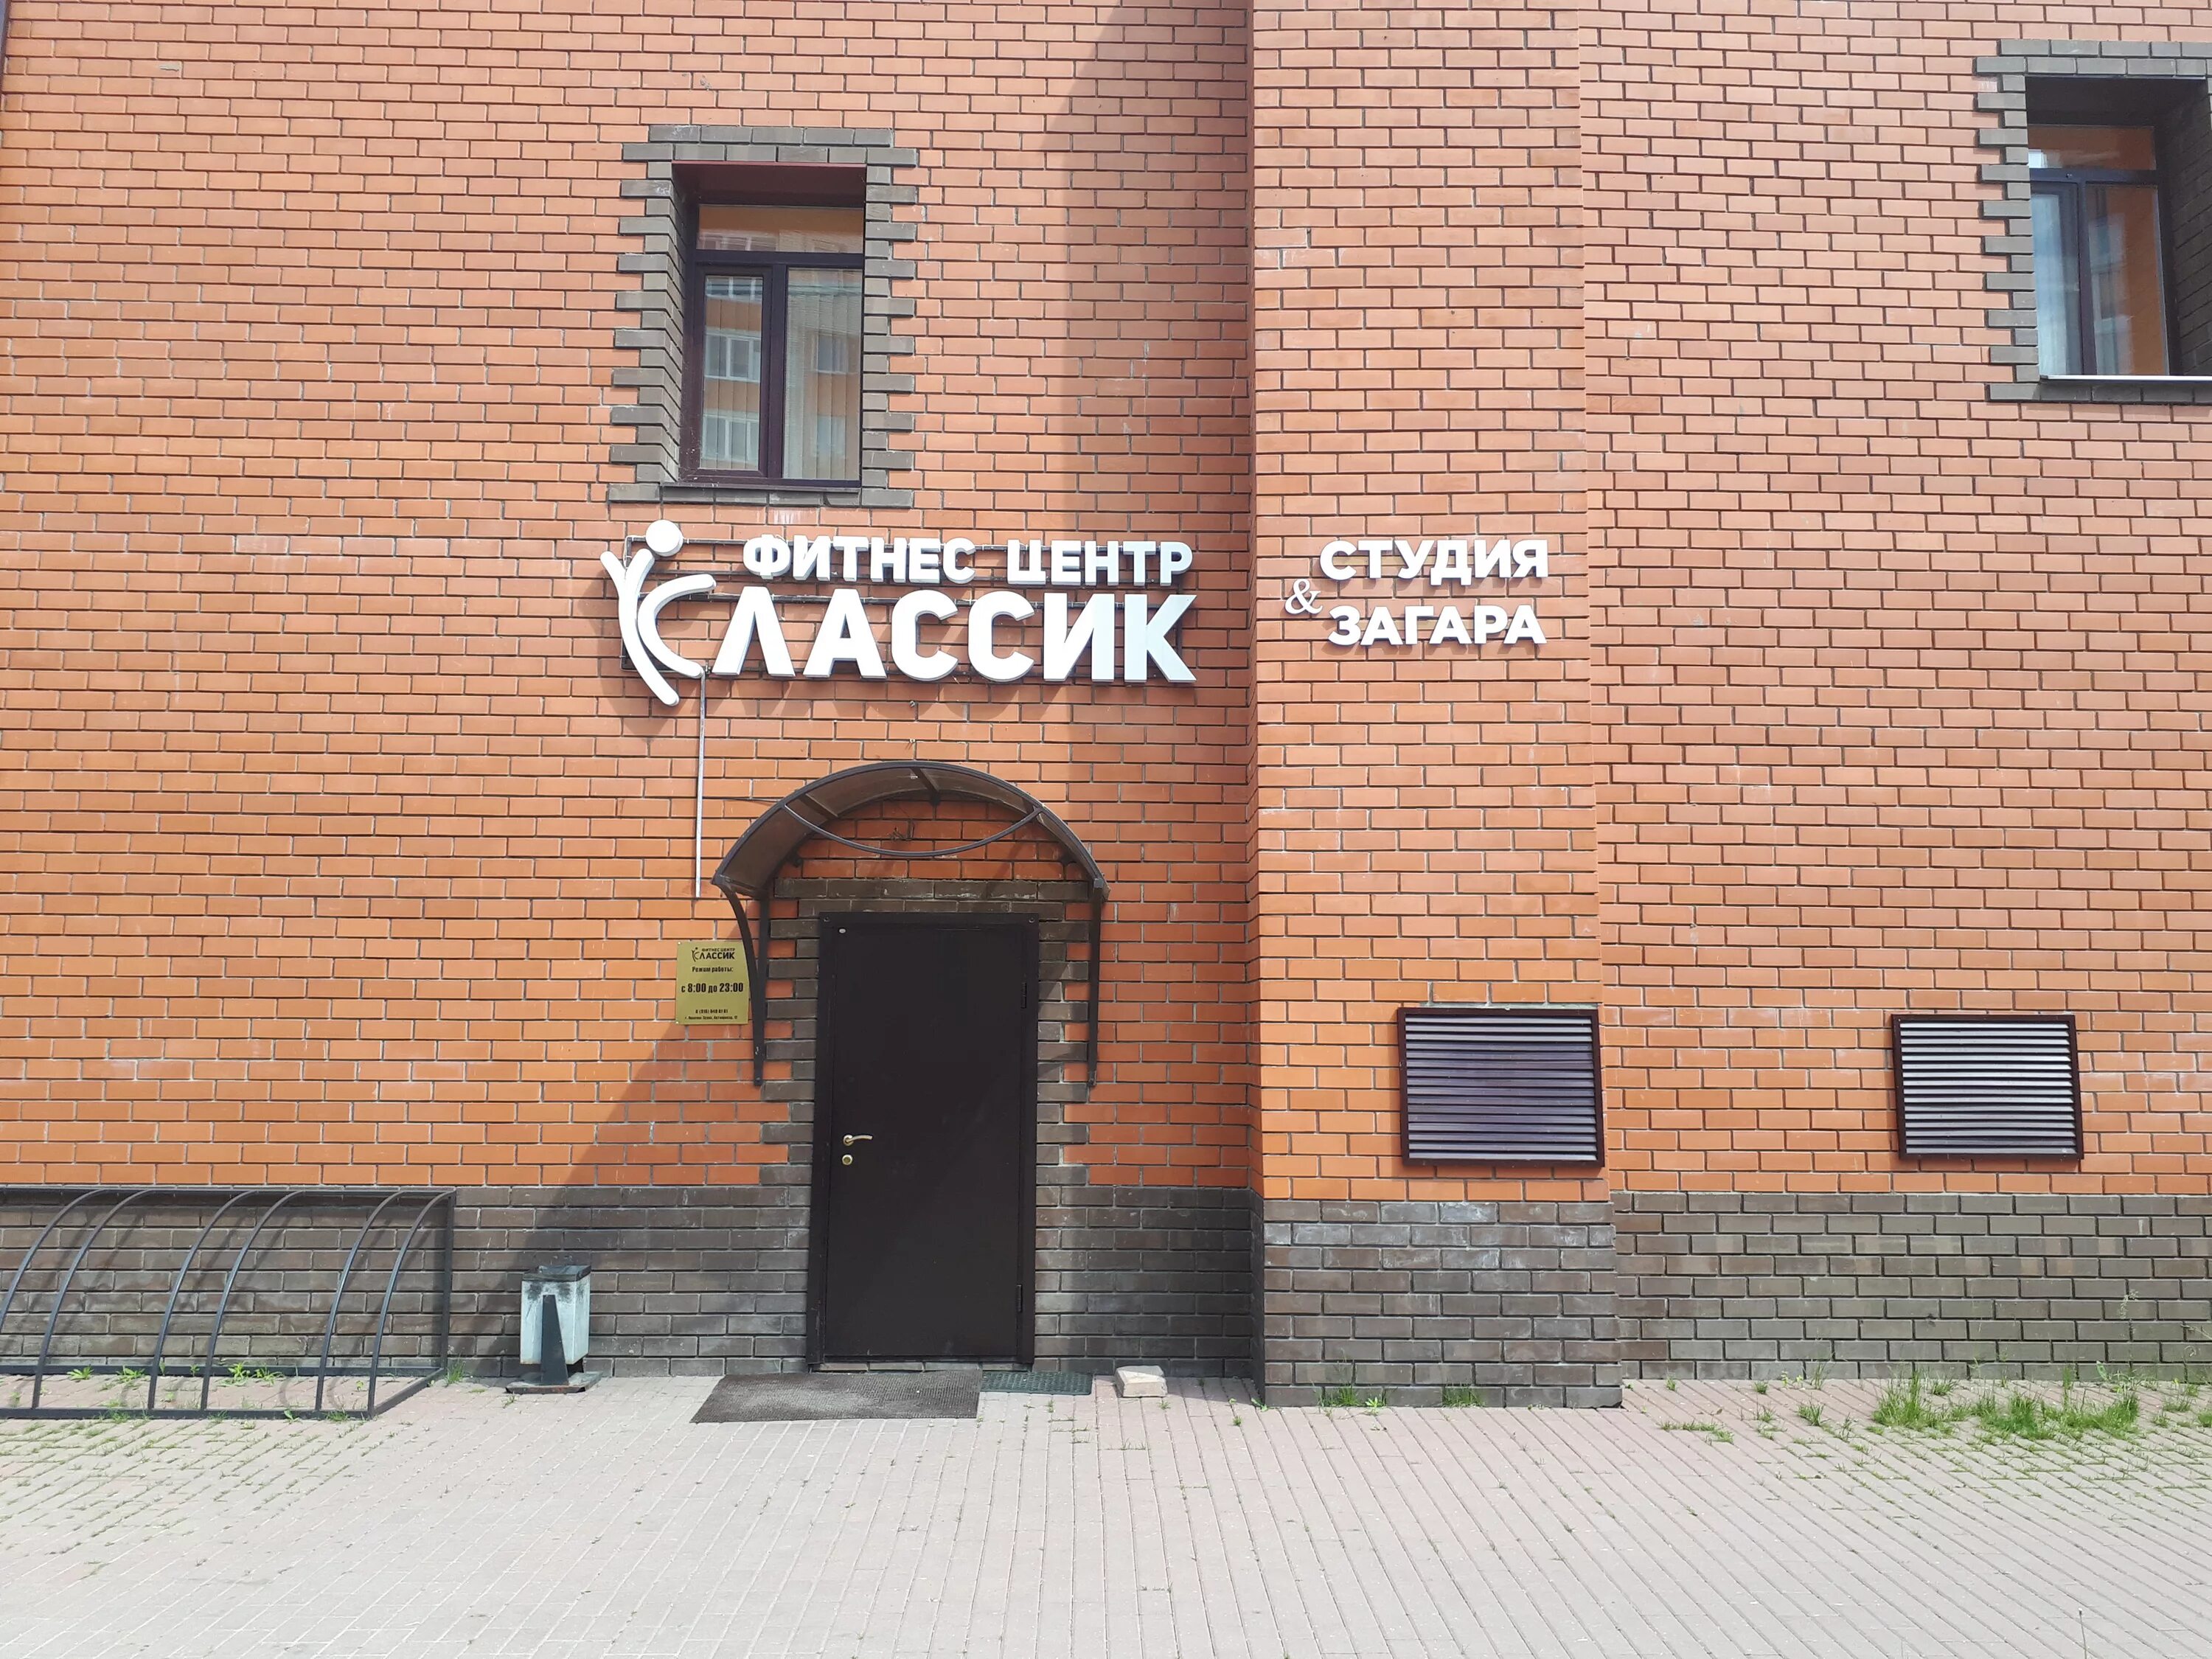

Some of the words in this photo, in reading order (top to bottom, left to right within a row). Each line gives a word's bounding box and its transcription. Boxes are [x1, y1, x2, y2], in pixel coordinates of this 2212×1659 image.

[743, 535, 976, 584] ФИТНЕС
[1007, 539, 1193, 586] ЦЕНТР
[1320, 539, 1548, 586] СТУДИЯ
[1284, 578, 1323, 615] &
[1328, 605, 1548, 646] ЗАГАРА
[687, 983, 706, 992] 8:00
[708, 985, 717, 993] до
[719, 982, 743, 992] 23:00
